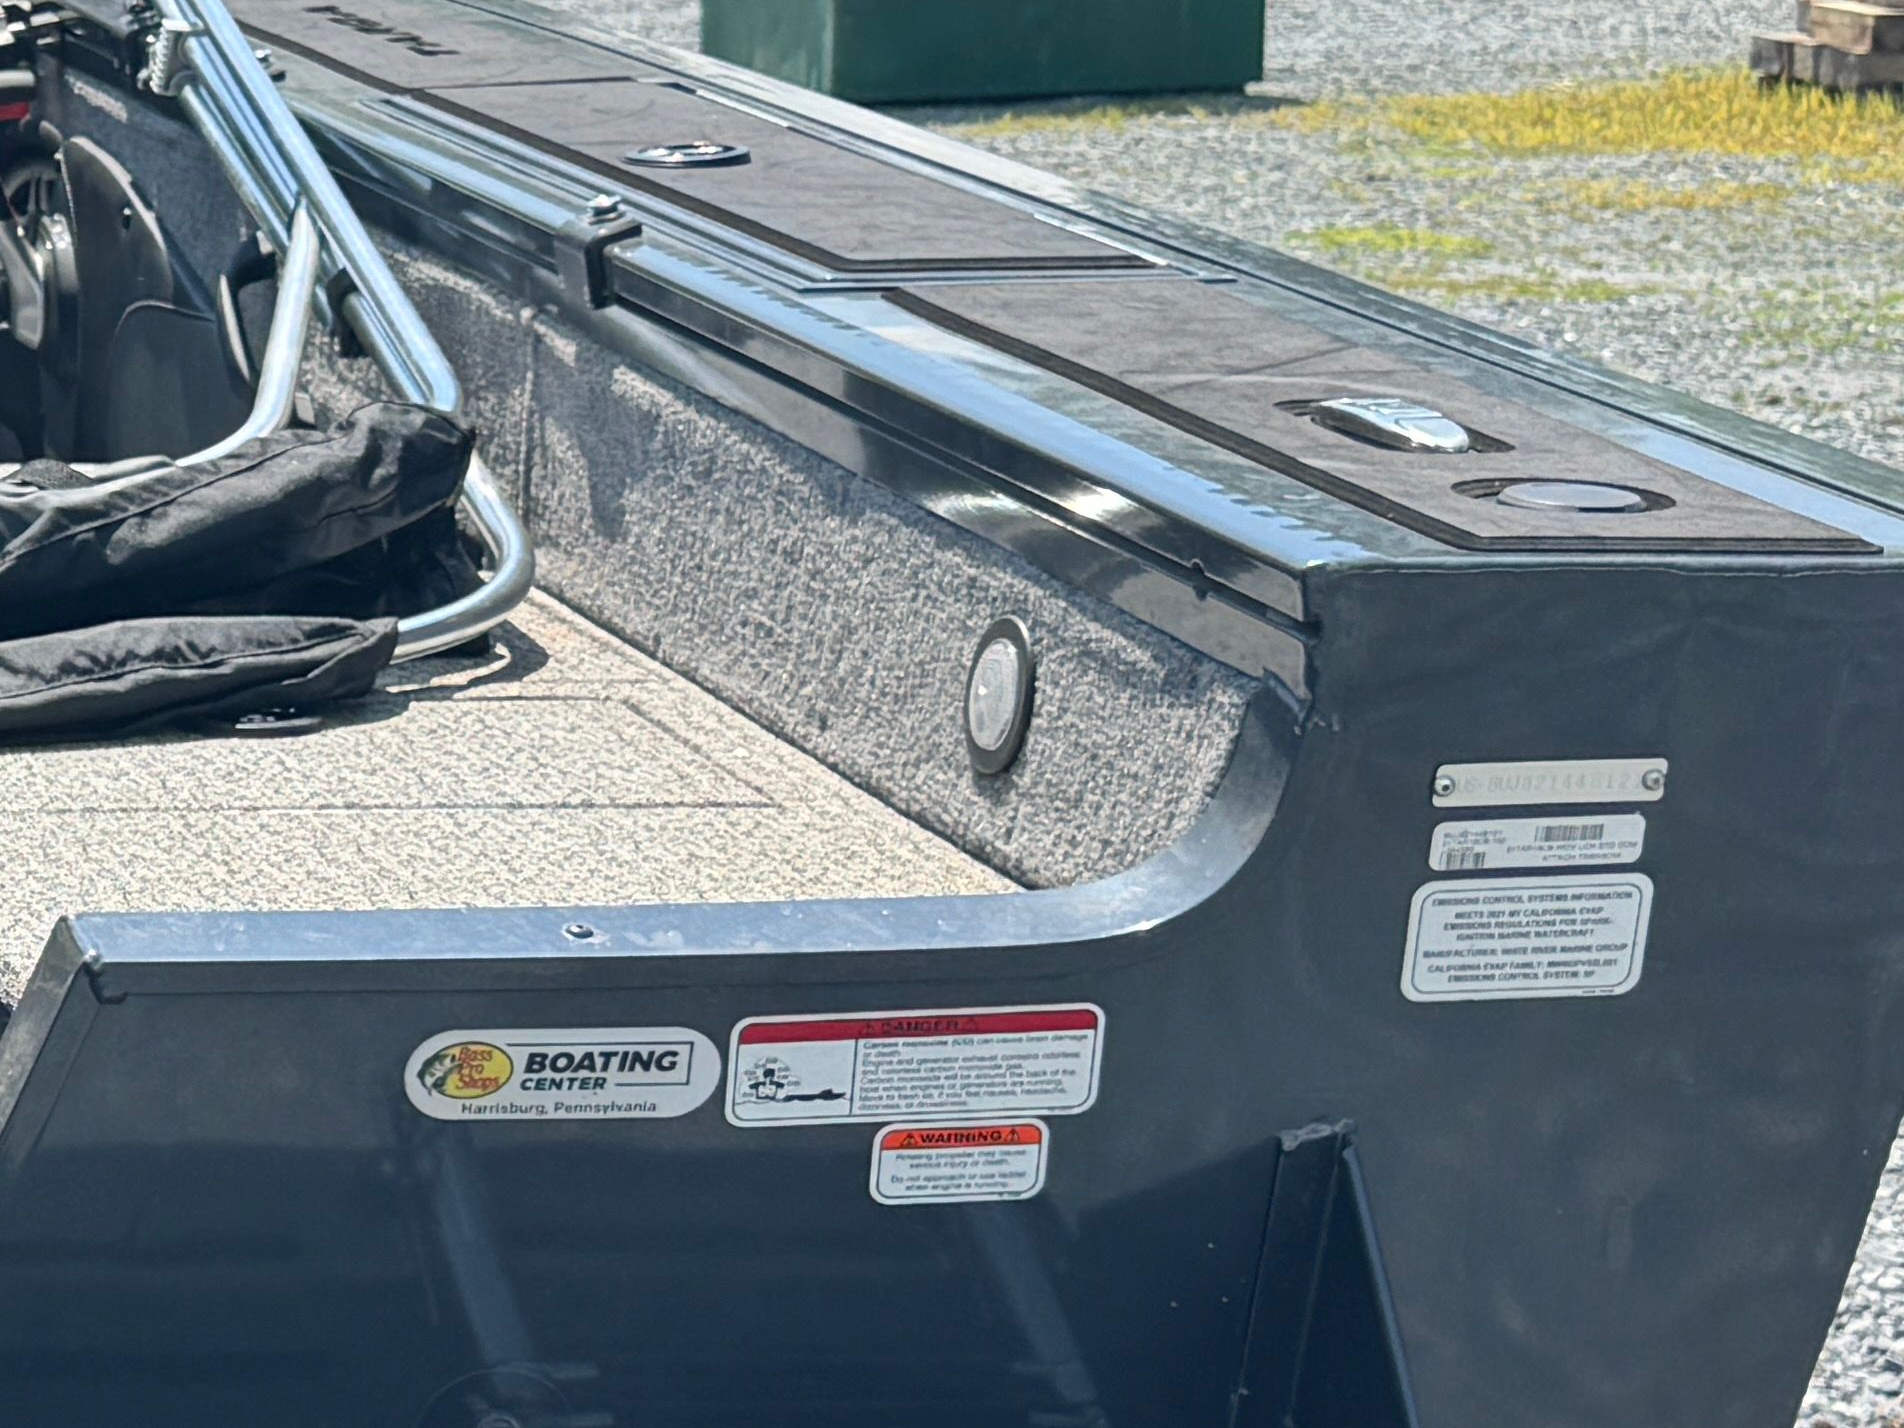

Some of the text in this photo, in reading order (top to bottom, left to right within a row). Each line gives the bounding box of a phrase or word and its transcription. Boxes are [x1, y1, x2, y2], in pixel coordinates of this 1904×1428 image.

[458, 1046, 493, 1062] Bass
[523, 1050, 679, 1073] BOATING
[459, 1062, 484, 1075] Pro
[455, 1074, 500, 1092] Shops
[520, 1076, 607, 1091] CENTER
[461, 1101, 657, 1116] Harrisburg, Pennsylvania
[919, 1130, 1002, 1144] WARNING
